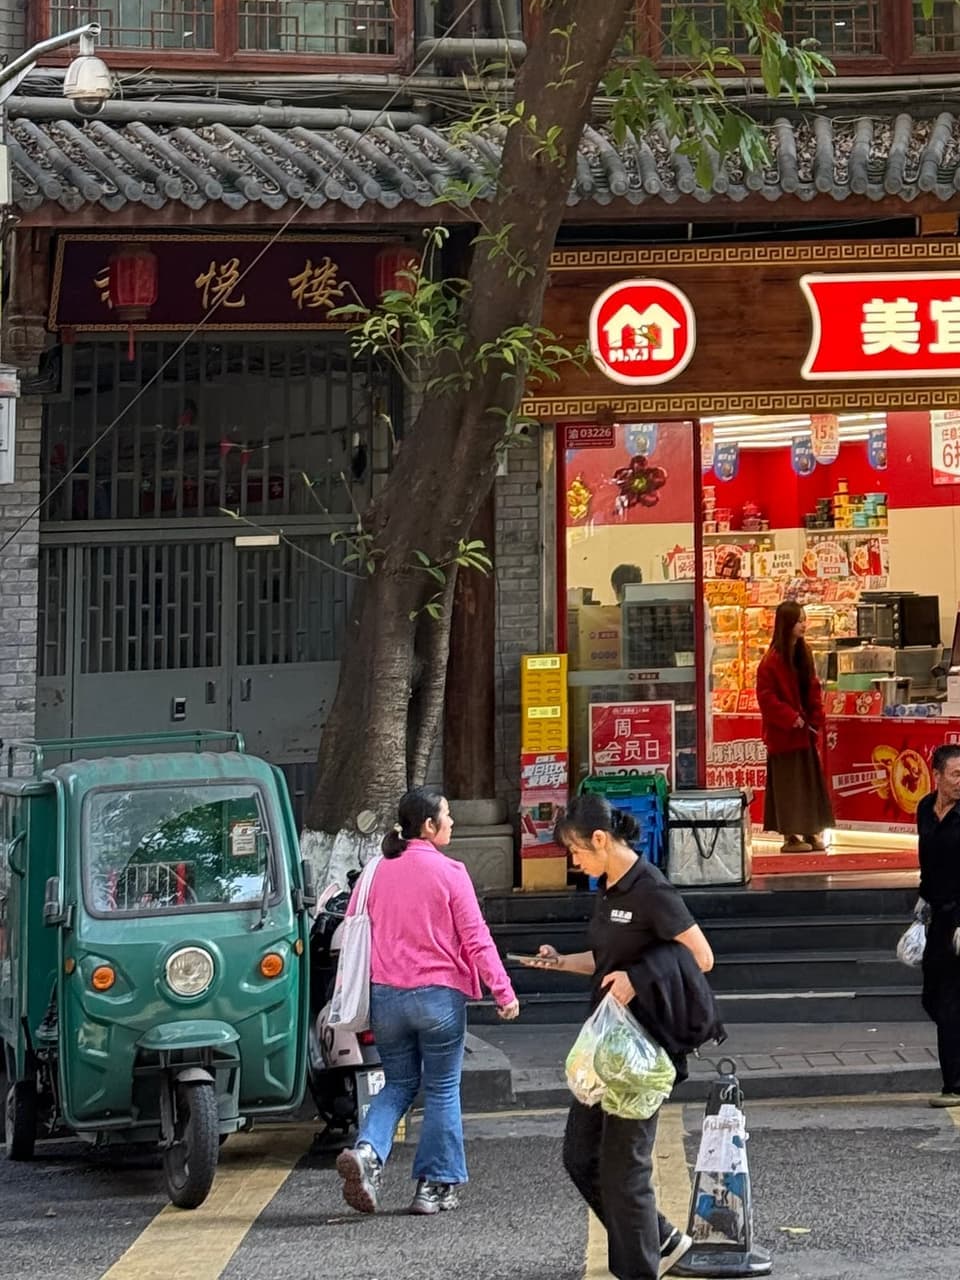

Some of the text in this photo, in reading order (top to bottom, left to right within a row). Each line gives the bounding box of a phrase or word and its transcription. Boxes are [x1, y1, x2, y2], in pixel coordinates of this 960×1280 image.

[580, 428, 612, 438] 03226
[614, 719, 651, 738] 周二
[604, 740, 659, 761] 会员日
